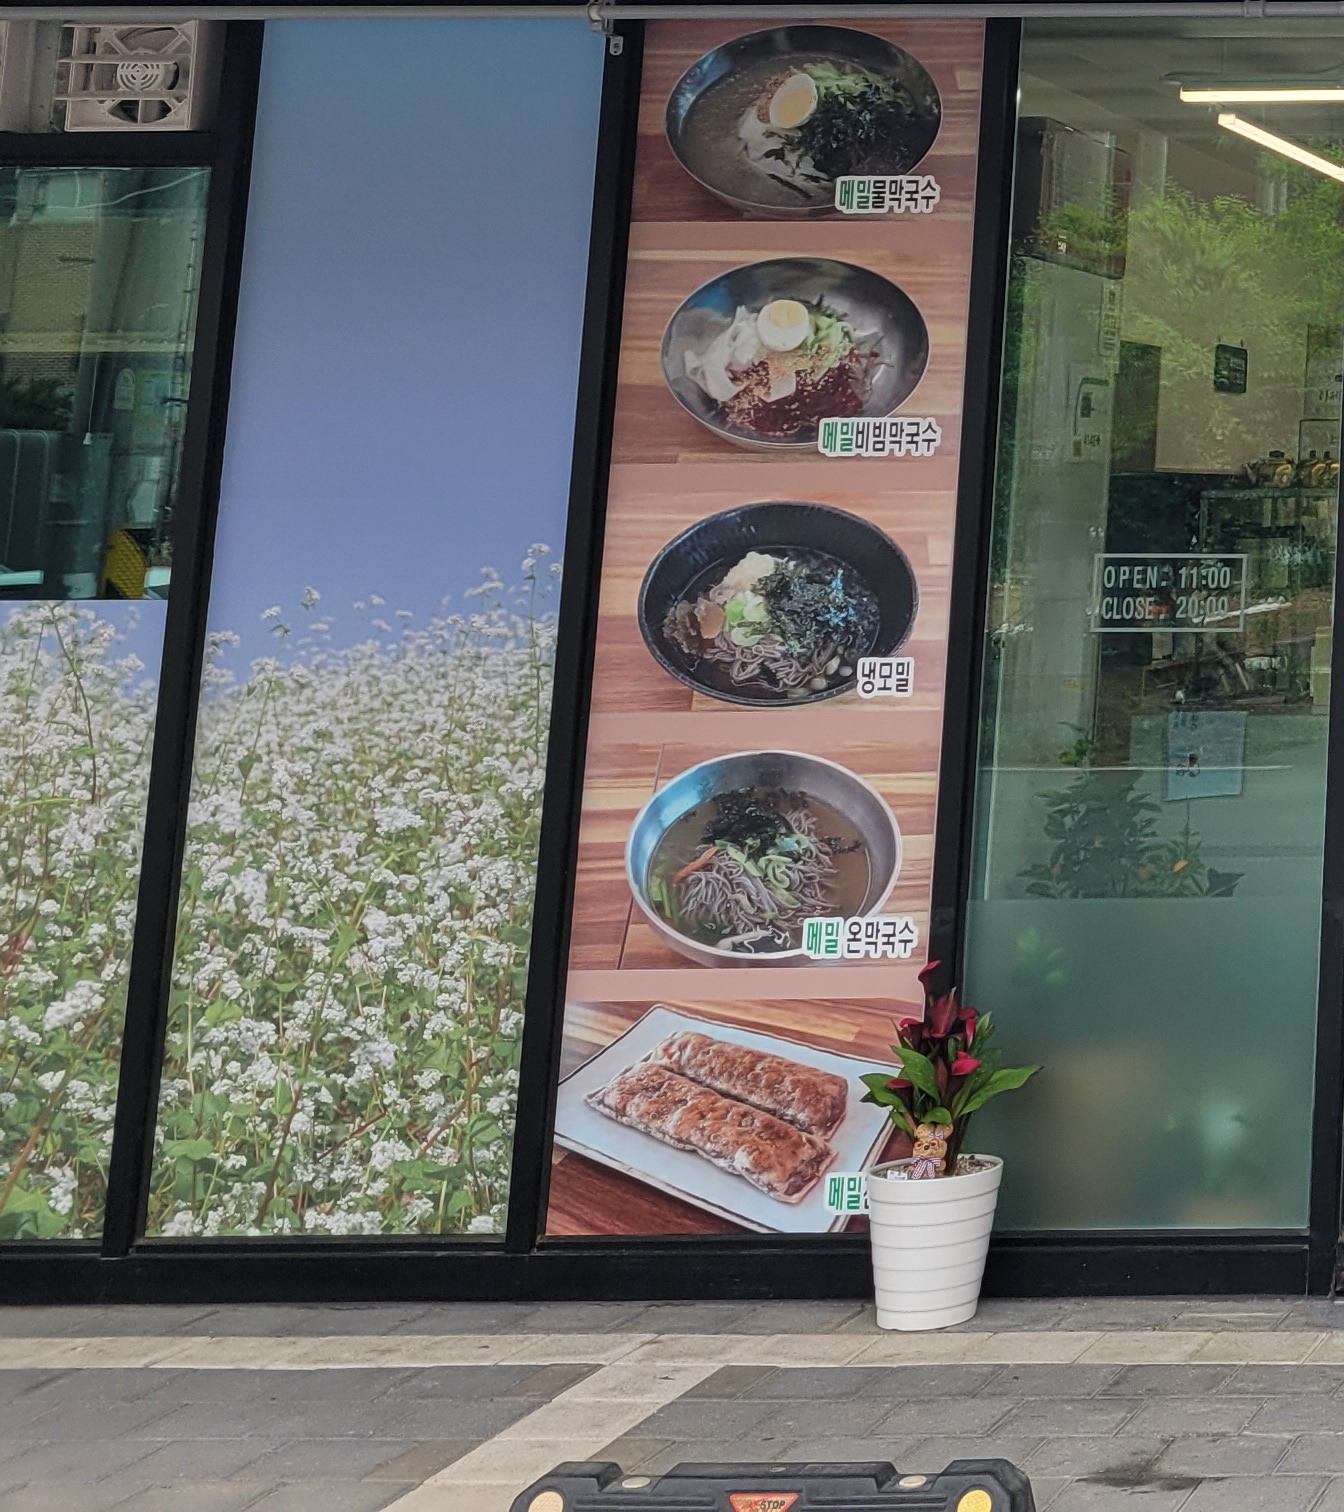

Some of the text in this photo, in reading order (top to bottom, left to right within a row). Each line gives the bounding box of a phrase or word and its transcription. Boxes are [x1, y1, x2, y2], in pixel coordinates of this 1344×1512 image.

[837, 179, 938, 211] 메밀물막국수
[821, 421, 938, 454] 메밀비빔막국수
[1178, 566, 1231, 589] 11:00
[1175, 596, 1229, 619] 20:00
[858, 660, 911, 694] 냉모밀
[805, 921, 915, 958] 메밀 온막국수
[759, 1500, 786, 1509] STOP
